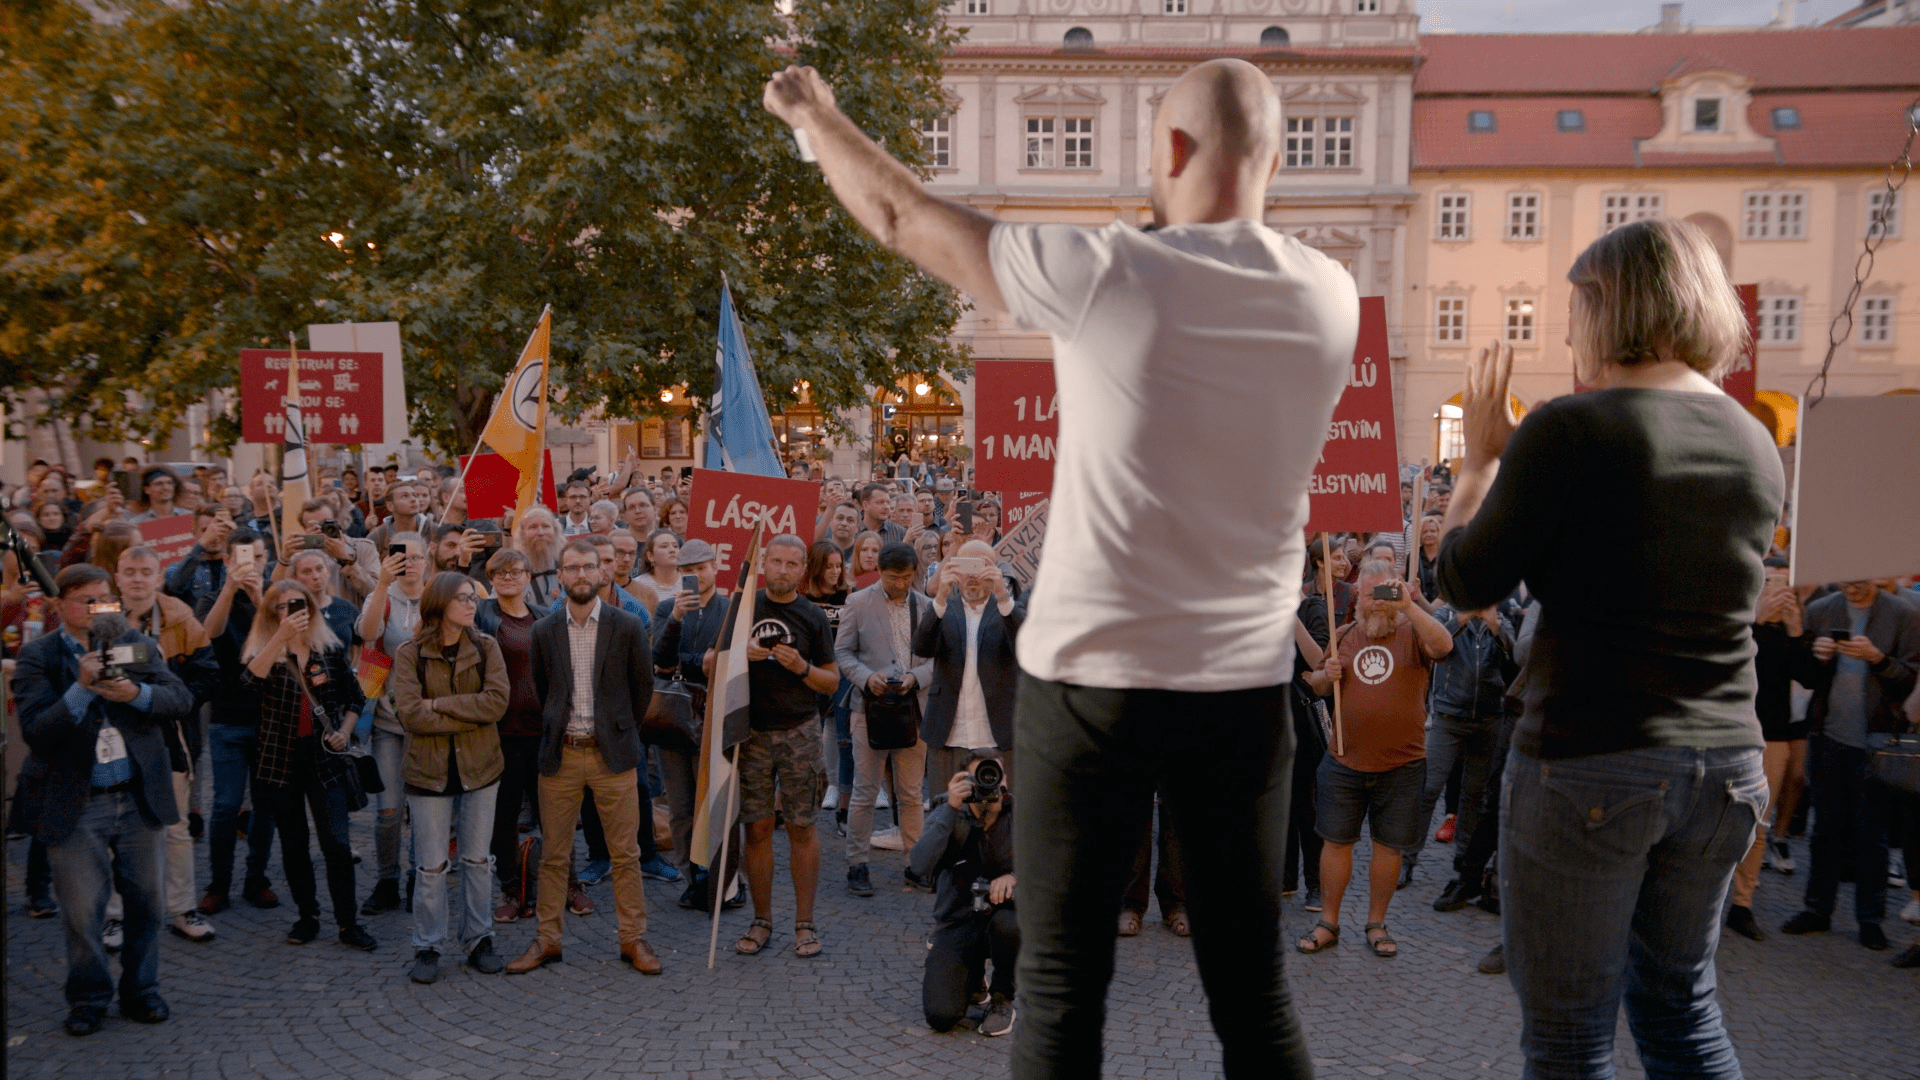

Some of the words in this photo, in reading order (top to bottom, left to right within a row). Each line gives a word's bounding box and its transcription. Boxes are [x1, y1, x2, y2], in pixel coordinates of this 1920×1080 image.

[338, 358, 360, 370] SE:
[1345, 357, 1377, 388] LŮ
[280, 396, 321, 408] BROU
[324, 396, 346, 408] SE:
[1013, 396, 1027, 421] 1
[1326, 419, 1382, 441] STVÍM
[982, 435, 995, 460] 1
[705, 493, 797, 535] LÁSKA
